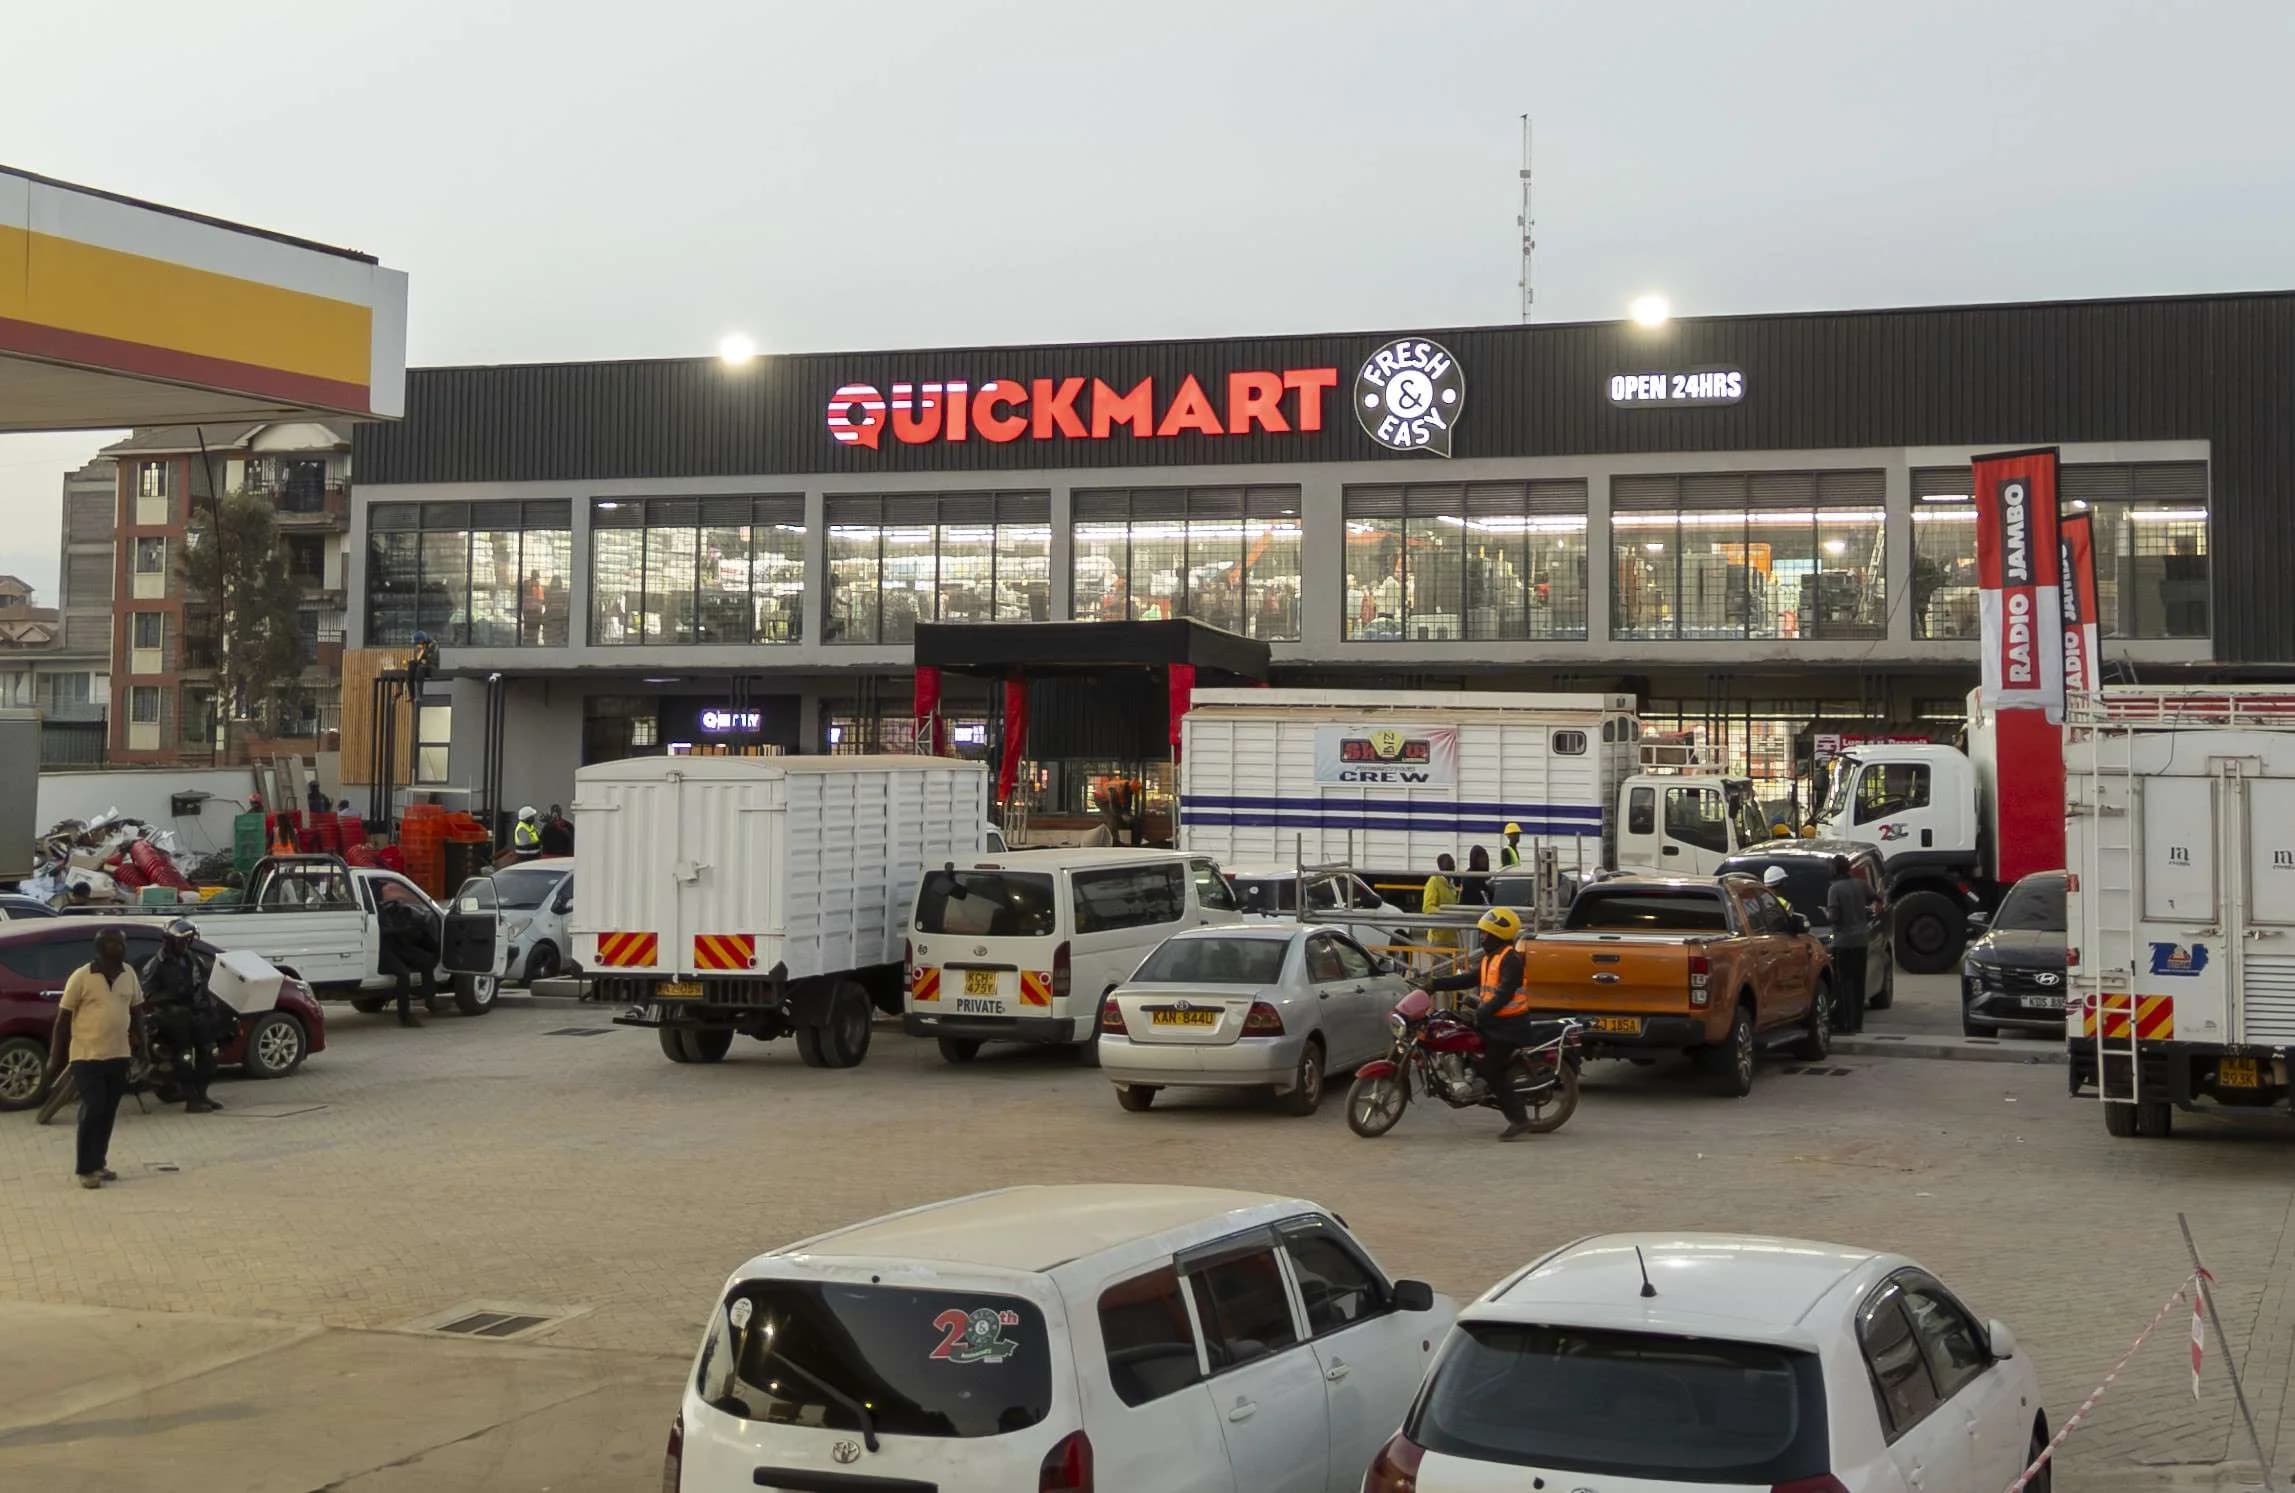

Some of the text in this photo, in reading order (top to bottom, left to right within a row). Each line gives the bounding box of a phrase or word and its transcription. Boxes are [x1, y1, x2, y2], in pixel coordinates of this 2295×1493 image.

[1363, 341, 1451, 387] FRESH
[1398, 379, 1423, 410] &
[1611, 371, 1742, 400] OPEN 24HRS
[827, 367, 1338, 450] QUICKMART
[1377, 407, 1447, 446] EASY
[2004, 482, 2031, 683] RADIO JAMBO
[1339, 771, 1430, 782] CREW
[957, 999, 1003, 1014] PRIVATE
